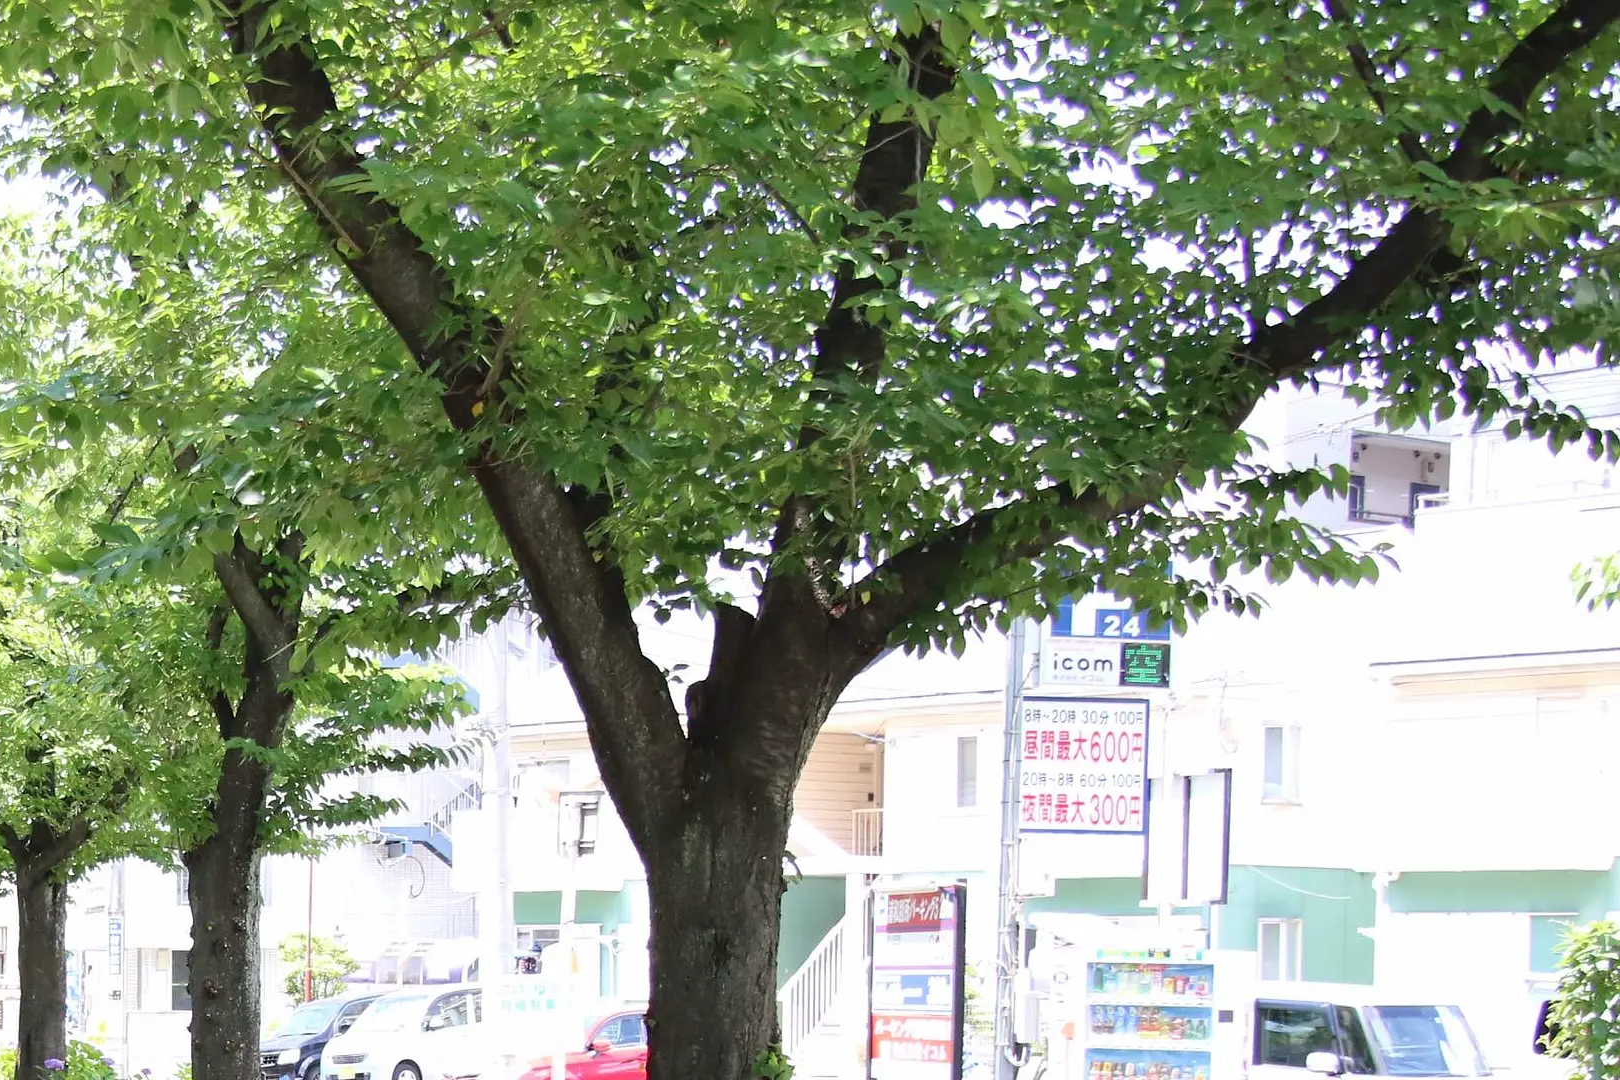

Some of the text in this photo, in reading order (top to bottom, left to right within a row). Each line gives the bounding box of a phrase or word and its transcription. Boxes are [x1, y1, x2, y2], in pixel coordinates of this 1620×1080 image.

[1102, 615, 1140, 637] 24
[1053, 652, 1113, 672] icom
[1124, 643, 1162, 684] 空
